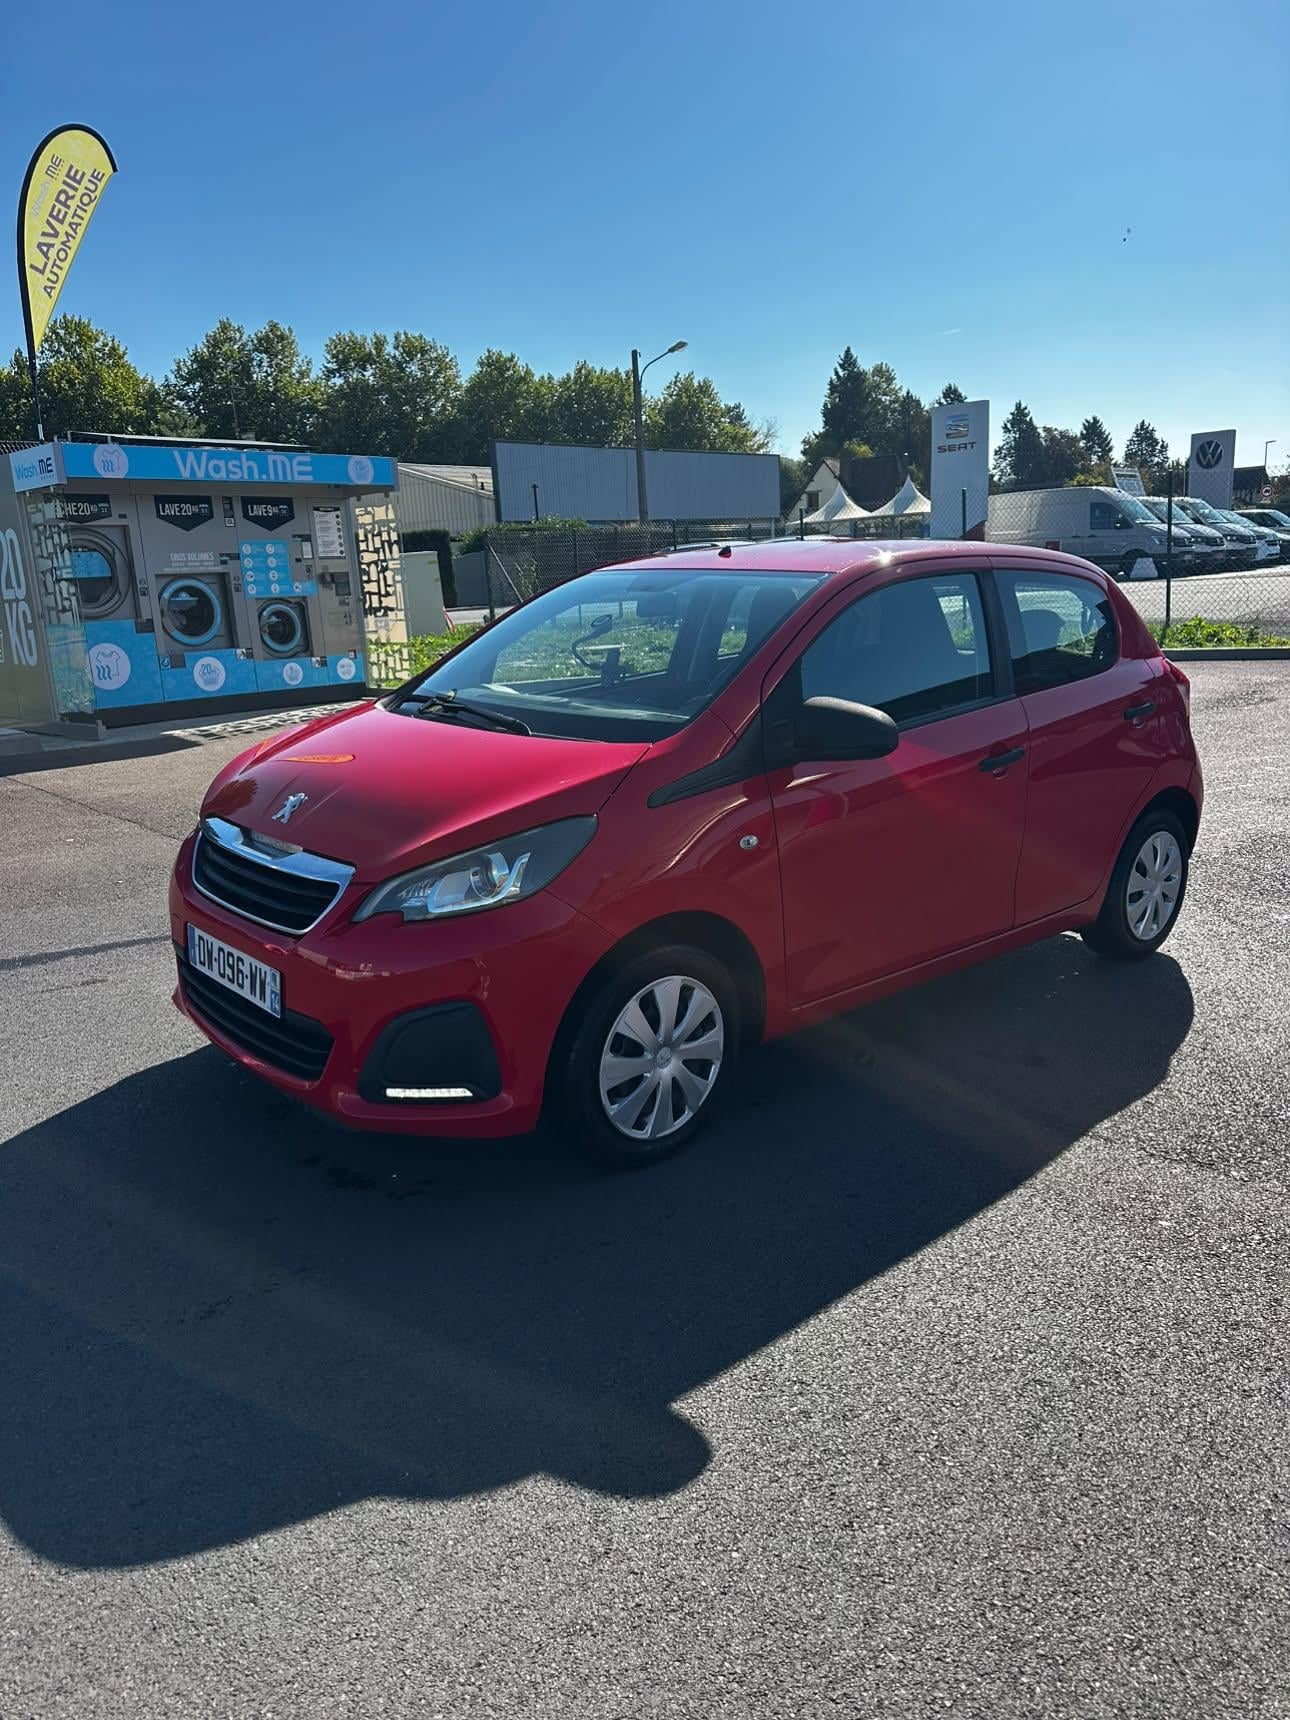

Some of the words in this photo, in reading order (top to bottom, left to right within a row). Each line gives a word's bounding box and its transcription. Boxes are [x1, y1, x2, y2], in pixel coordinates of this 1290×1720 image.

[29, 163, 86, 275] LAVERIE
[43, 168, 105, 299] AUTOMATIQUE
[937, 441, 977, 453] SEAT
[5, 601, 37, 667] KG
